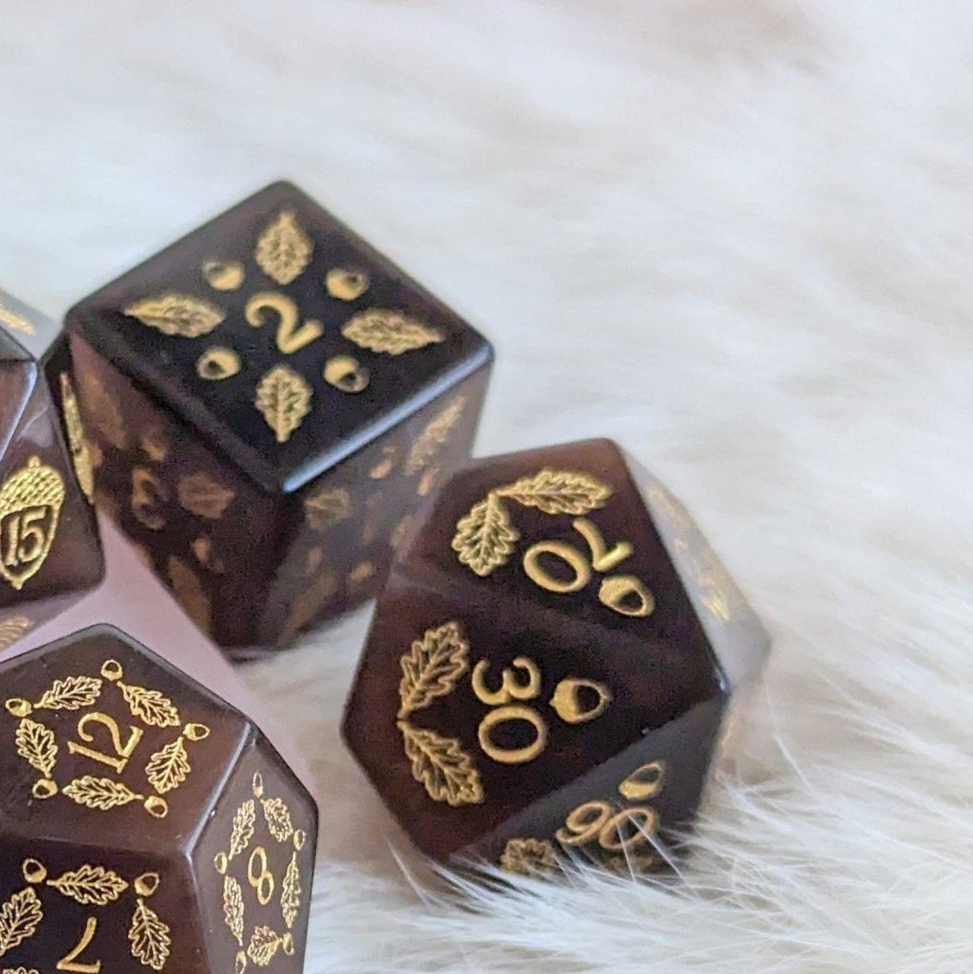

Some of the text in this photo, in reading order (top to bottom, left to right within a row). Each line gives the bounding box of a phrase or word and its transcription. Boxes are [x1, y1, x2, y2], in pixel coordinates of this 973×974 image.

[245, 291, 324, 354] 2
[6, 513, 46, 568] 15
[523, 517, 634, 594] 70
[472, 655, 550, 764] 30
[67, 711, 144, 774] 12
[247, 846, 275, 905] 8
[56, 916, 101, 974] 7
